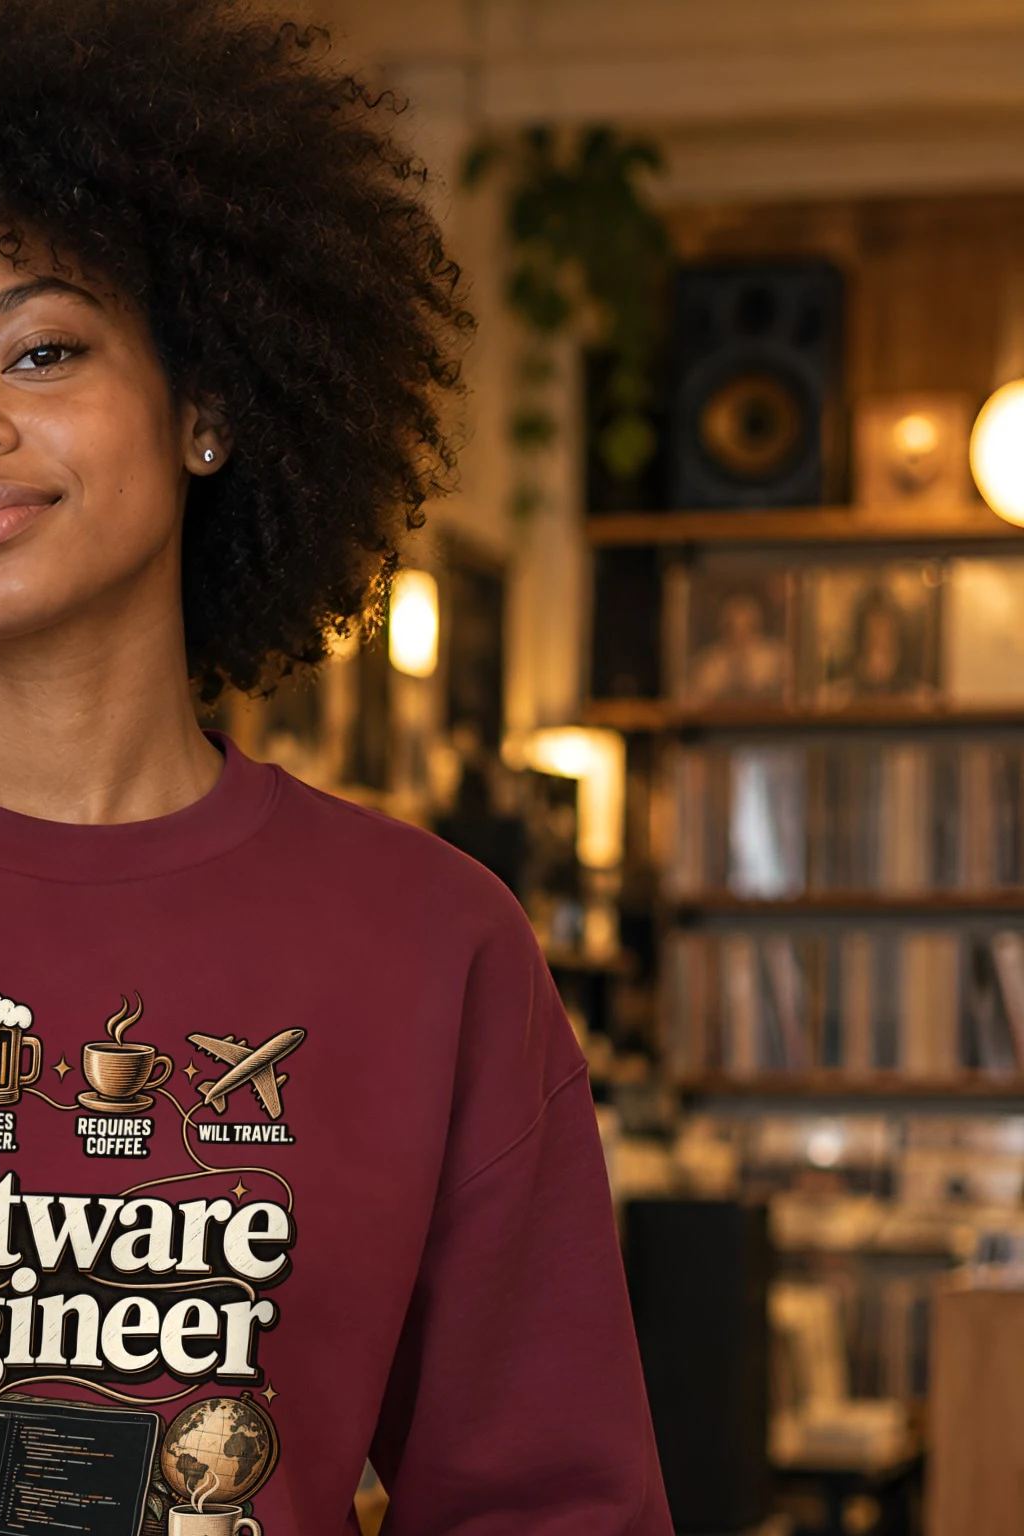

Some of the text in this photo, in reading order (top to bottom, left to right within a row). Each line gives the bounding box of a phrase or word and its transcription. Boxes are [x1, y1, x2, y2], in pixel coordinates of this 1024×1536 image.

[77, 1117, 152, 1137] REQUIRES
[198, 1124, 293, 1142] WILL TRAVEL.
[86, 1137, 147, 1155] COFFEE.
